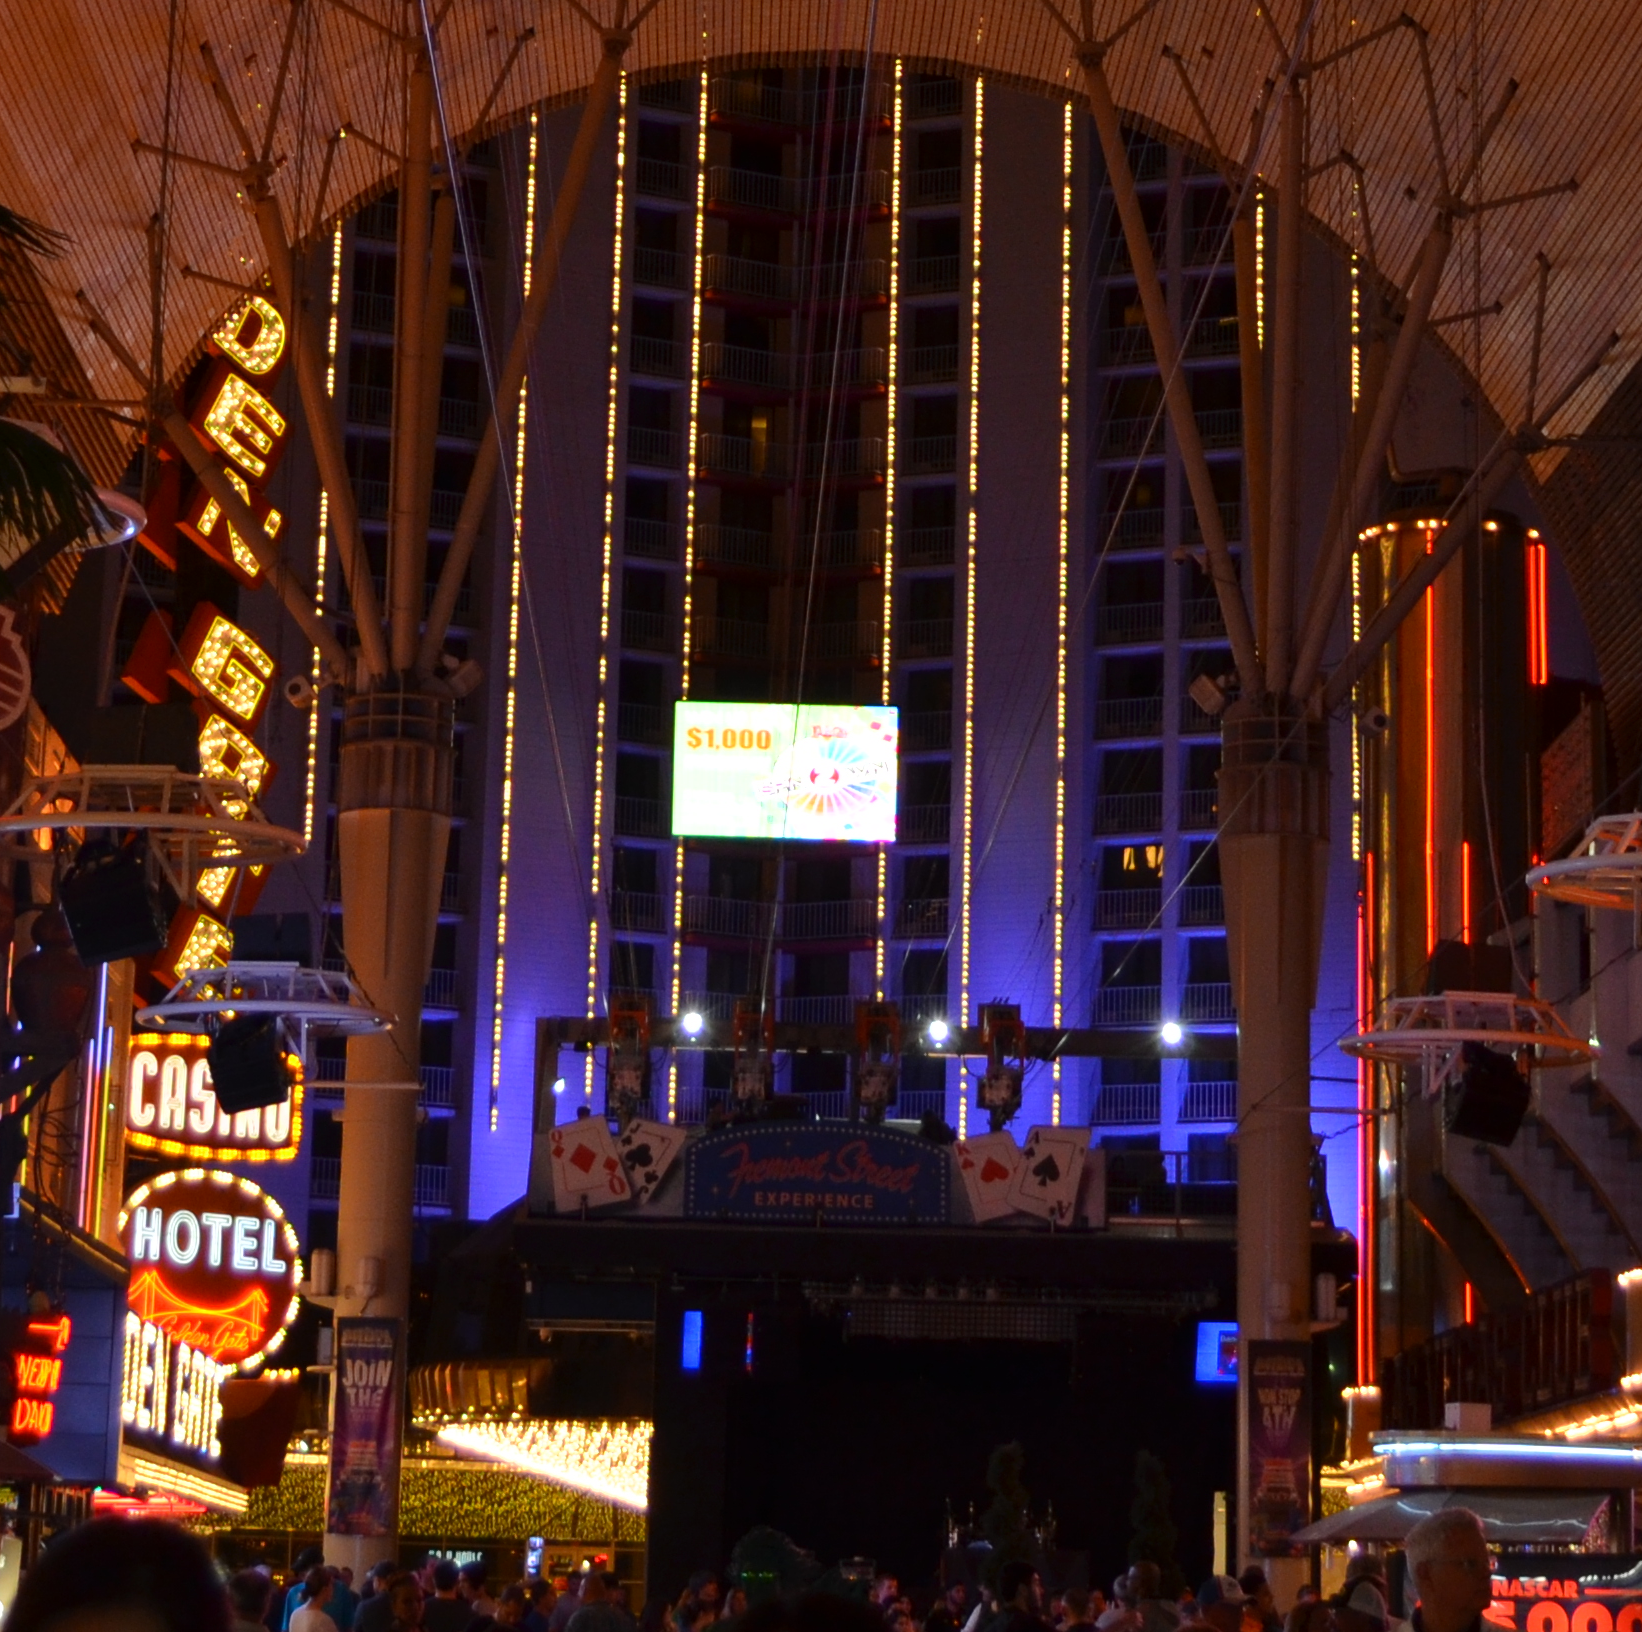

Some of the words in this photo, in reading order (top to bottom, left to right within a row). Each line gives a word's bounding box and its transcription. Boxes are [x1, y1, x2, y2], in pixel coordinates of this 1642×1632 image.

[196, 294, 288, 578] DEN
[686, 727, 772, 750] $1,000
[719, 1142, 831, 1199] Fremont
[828, 1140, 920, 1193] Street
[754, 1191, 875, 1210] EXPERIENCE
[134, 1206, 287, 1274] HOTEL
[159, 1314, 210, 1348] Golden
[213, 1321, 250, 1361] Gate
[342, 1358, 394, 1387] JOIN
[347, 1388, 383, 1408] THE
[1491, 1578, 1579, 1599] NASCAR
